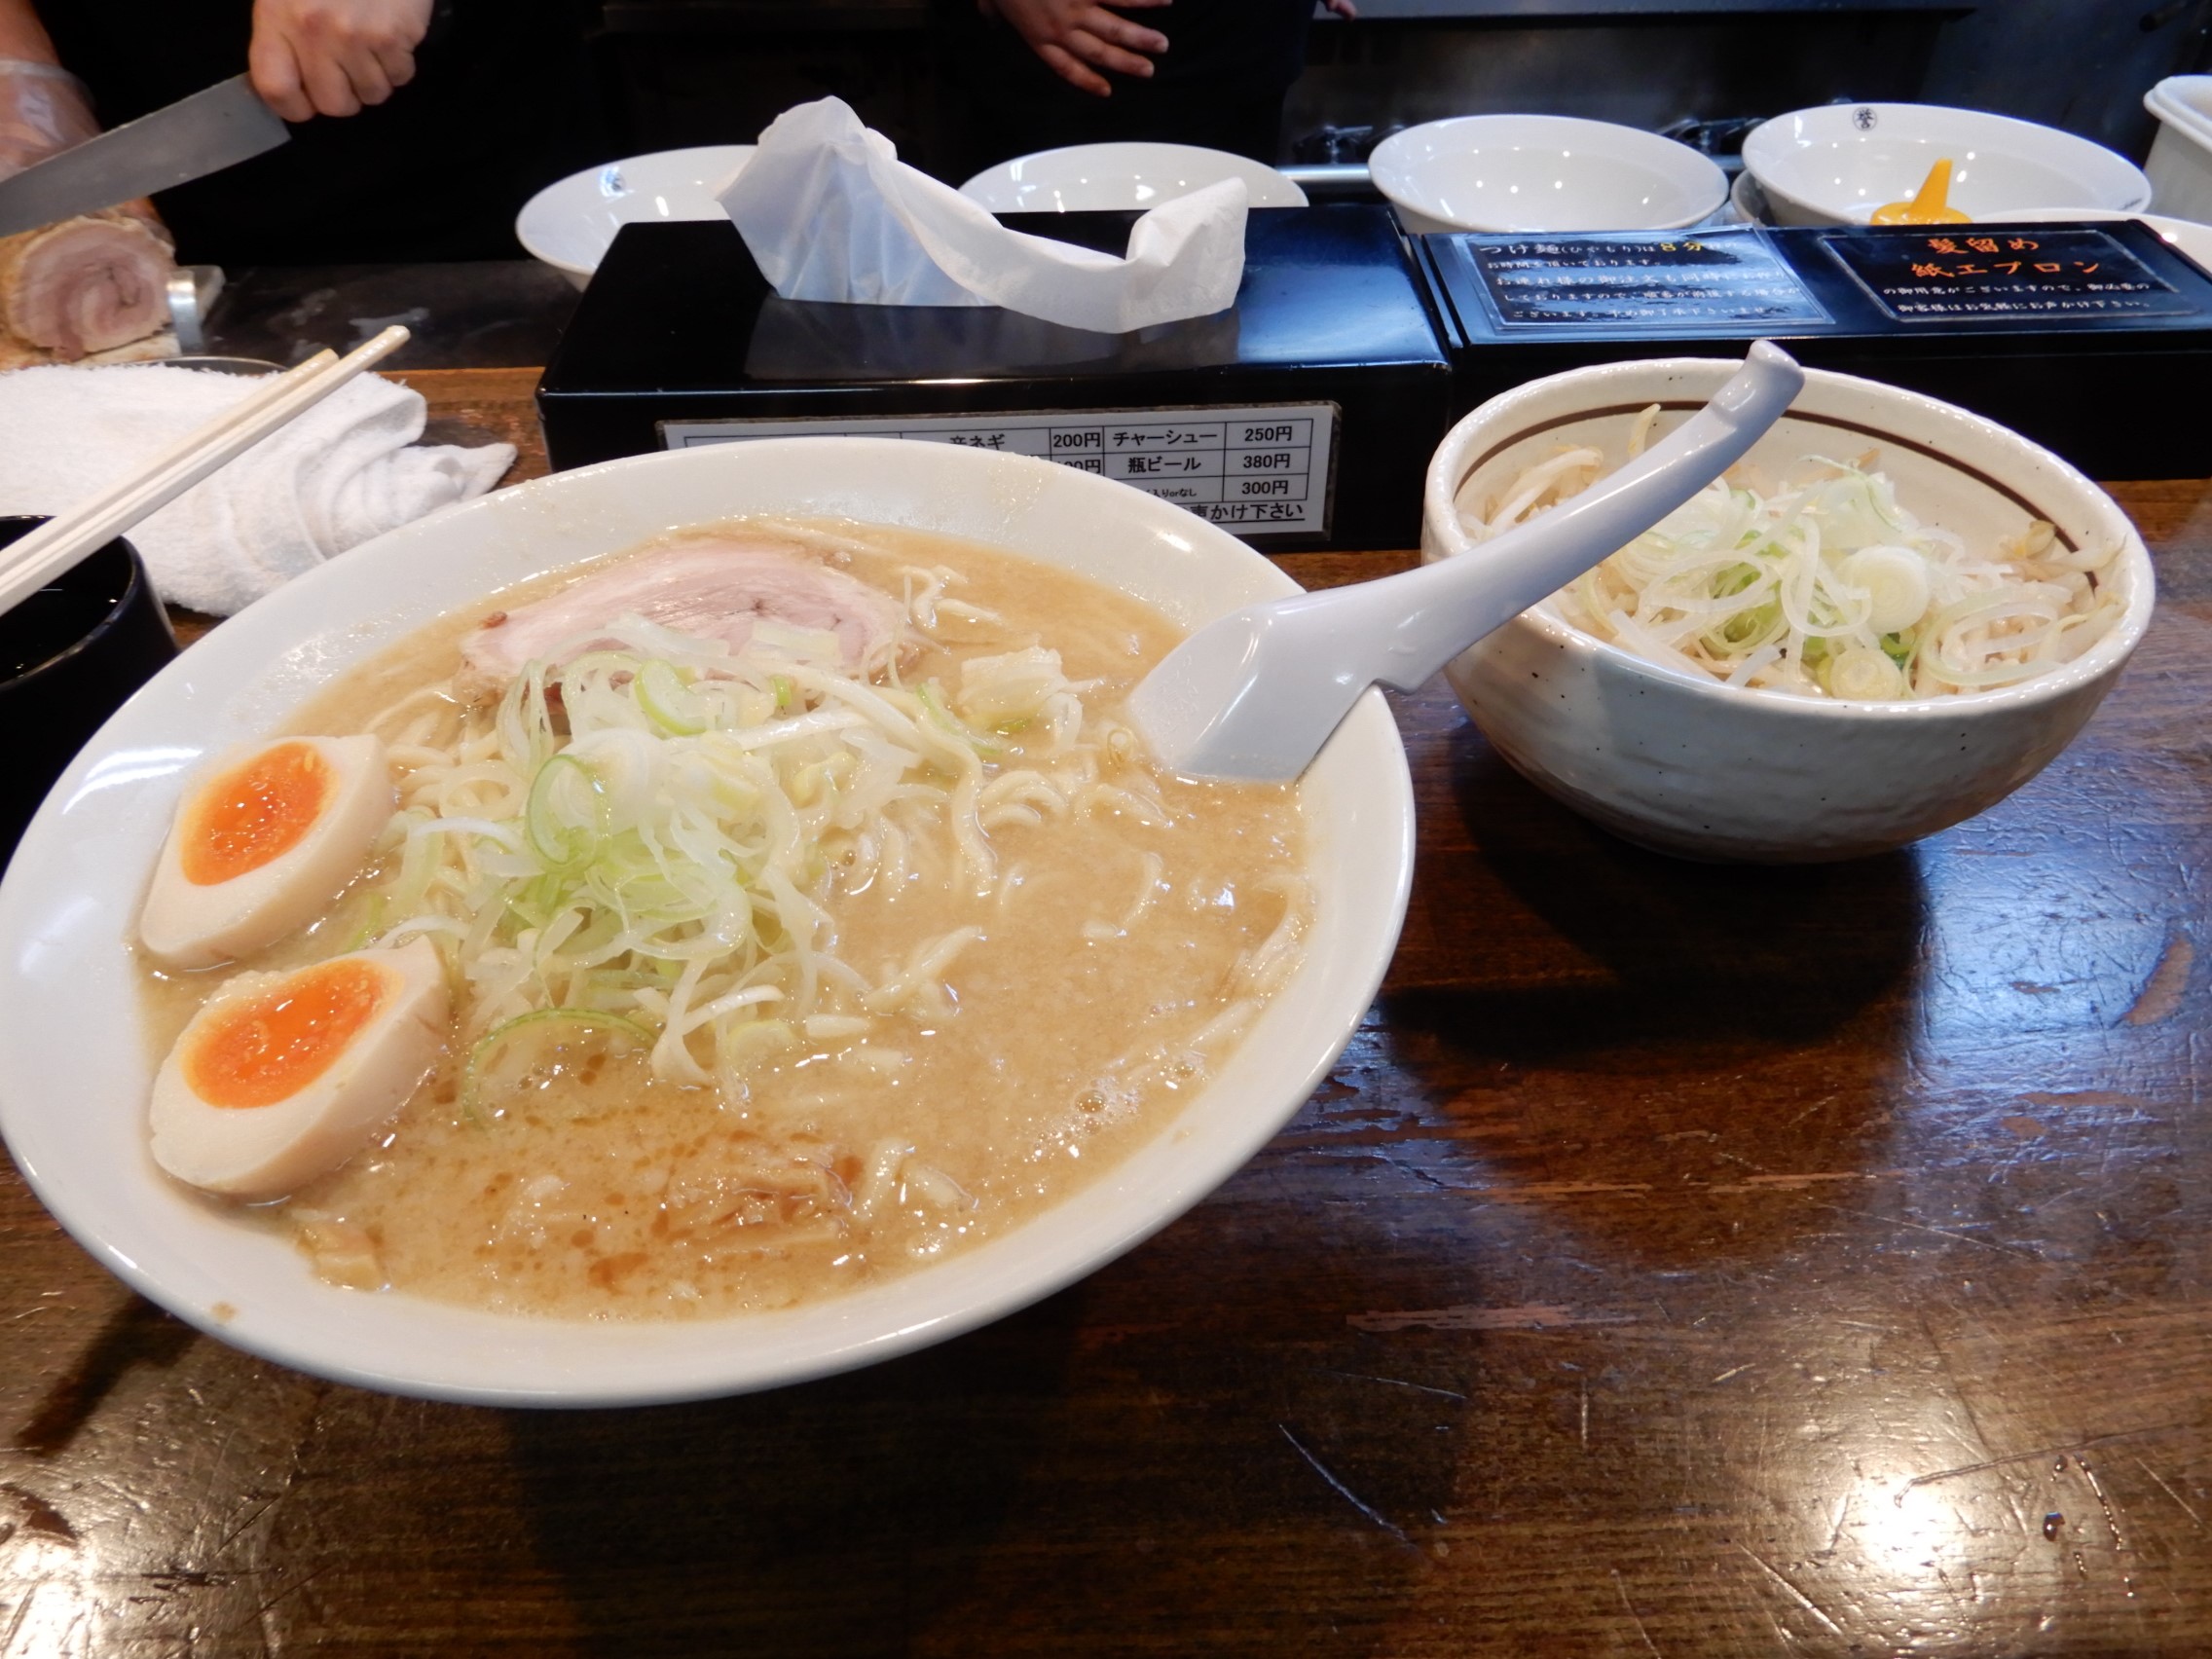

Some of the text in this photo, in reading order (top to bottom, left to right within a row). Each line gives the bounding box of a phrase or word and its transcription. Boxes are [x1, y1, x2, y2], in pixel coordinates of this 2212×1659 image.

[1928, 238, 2039, 254] 髪留め
[1911, 260, 2099, 278] 紙エプロン
[1053, 432, 1101, 448] 200円
[1113, 428, 1218, 447] チャーシュー
[1244, 425, 1292, 442] 250円
[1127, 456, 1201, 474] 瓶ビール
[1243, 454, 1291, 469] 380円
[1241, 480, 1289, 496] 300円
[1186, 503, 1304, 520] 声かけ下さい
